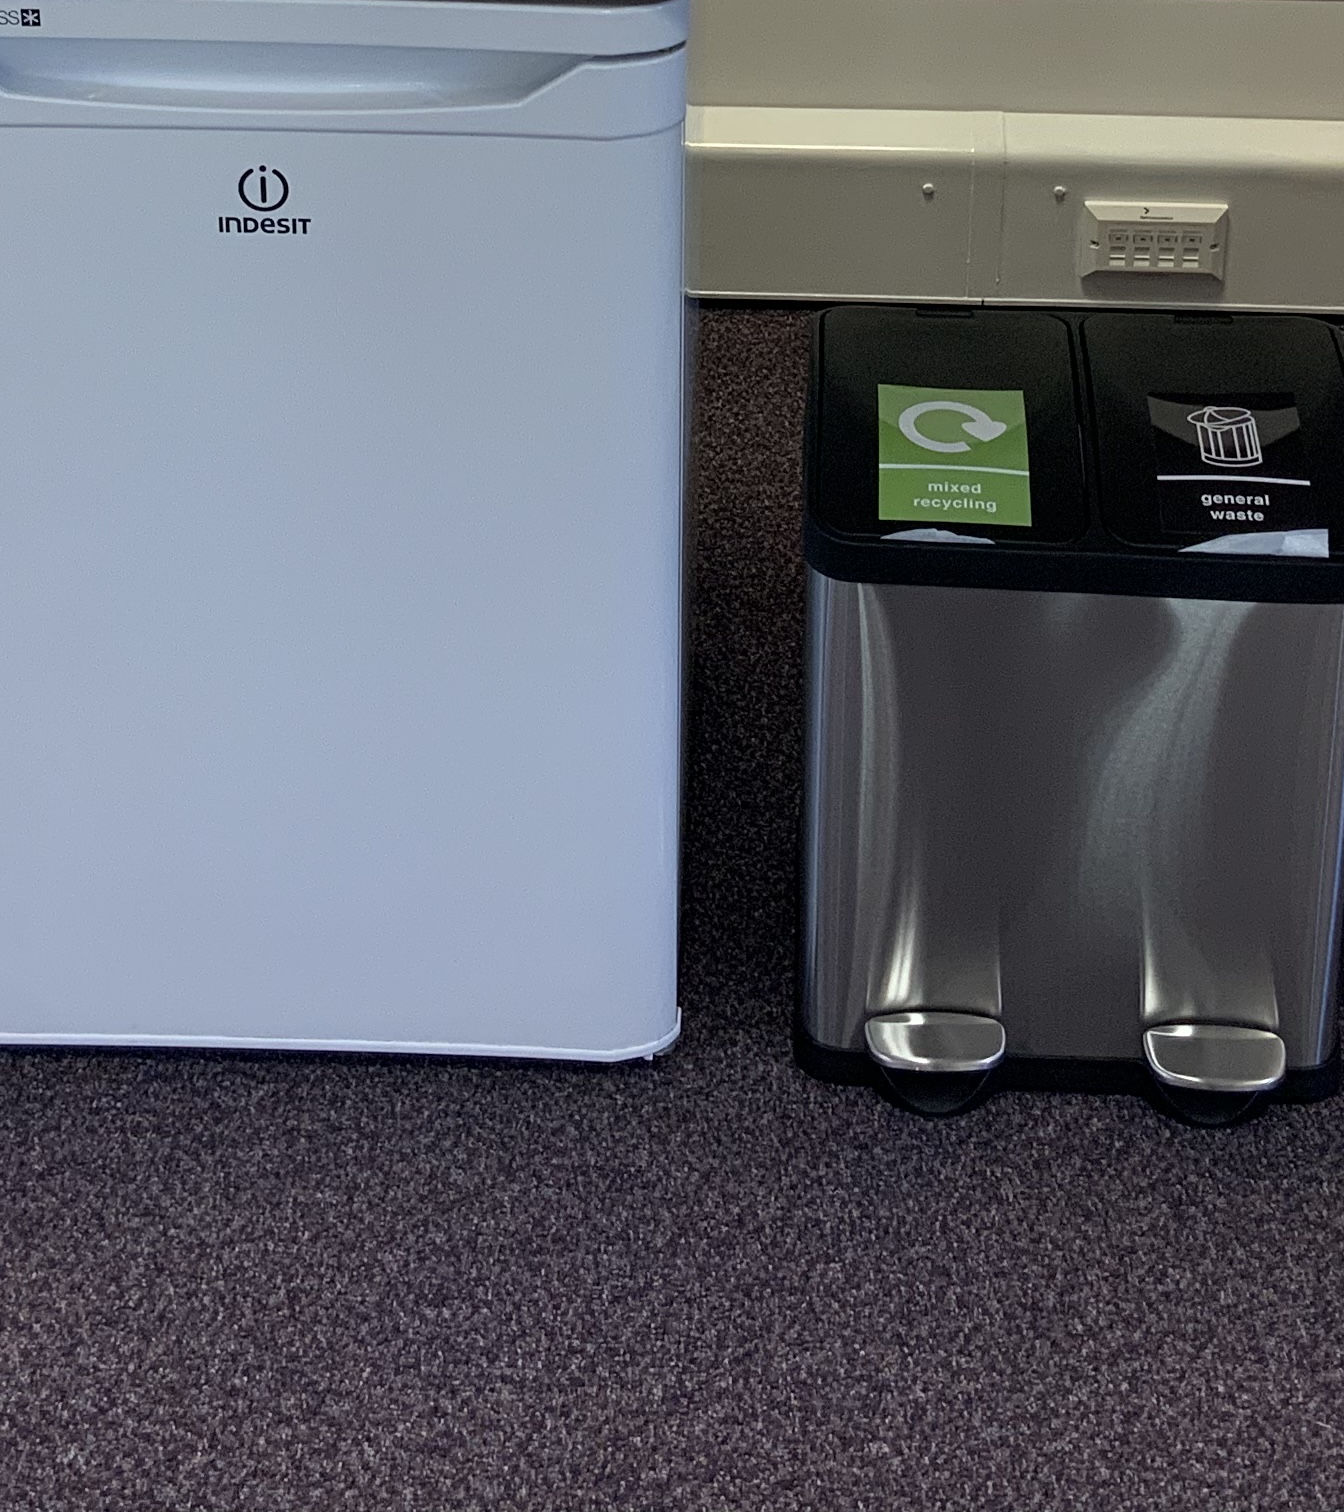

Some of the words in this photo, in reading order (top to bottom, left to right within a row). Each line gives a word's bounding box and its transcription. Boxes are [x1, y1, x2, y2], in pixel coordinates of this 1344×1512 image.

[218, 216, 312, 234] INDESIT
[927, 481, 982, 494] mixed
[913, 497, 997, 513] recycling
[1200, 494, 1270, 506] general
[1209, 510, 1265, 522] waste
